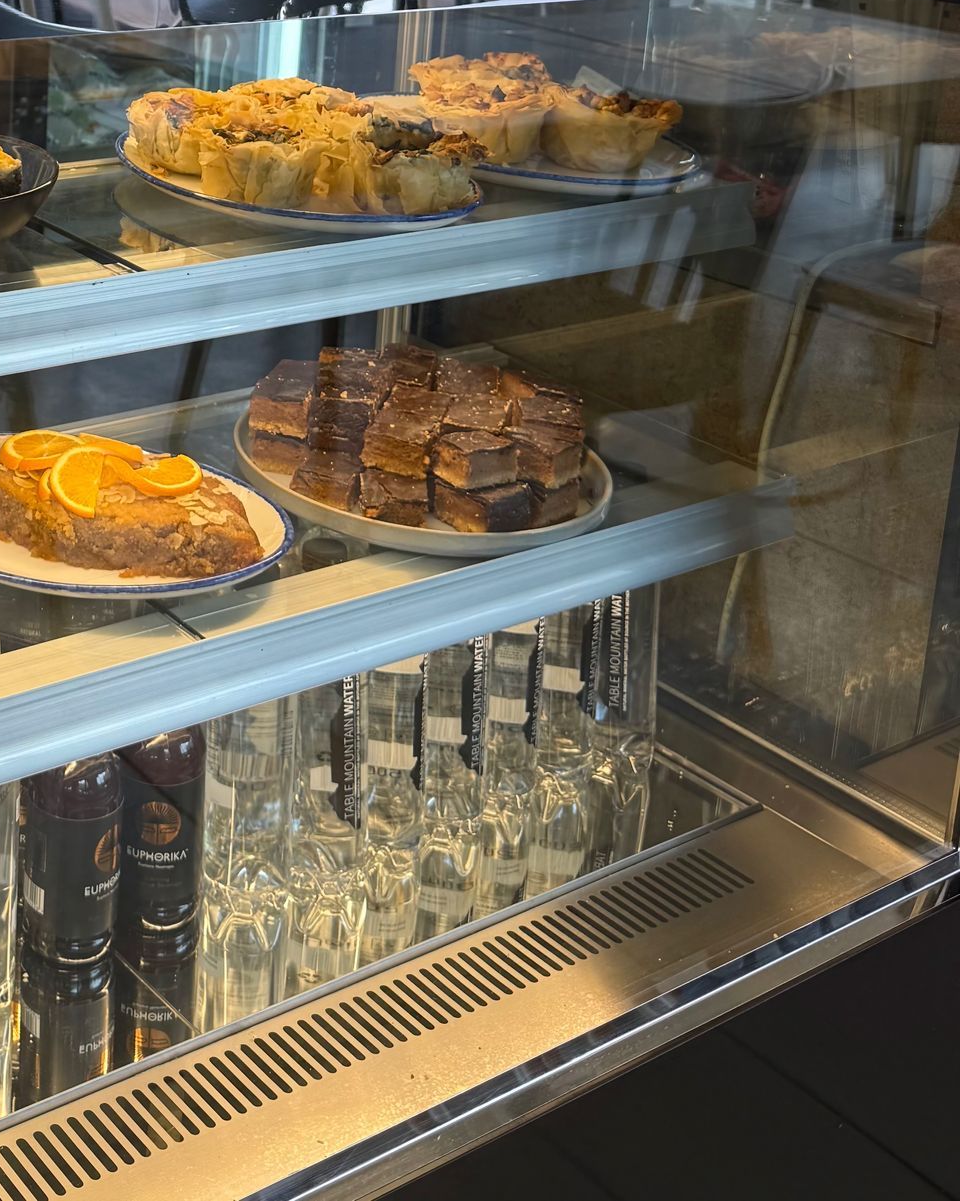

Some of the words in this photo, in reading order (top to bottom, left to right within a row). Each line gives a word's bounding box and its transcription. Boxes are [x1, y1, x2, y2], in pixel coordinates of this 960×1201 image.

[586, 681, 594, 712] TABLE
[590, 622, 600, 679] MOUNTAIN
[609, 618, 621, 674] MOUNTAIN
[472, 674, 482, 732] MOUNTAIN
[609, 676, 619, 707] TABLE
[344, 718, 353, 782] MOUNTAIN
[471, 735, 480, 768] TABLE
[344, 785, 354, 819] TABLE
[126, 845, 187, 862] EUPHORIKA
